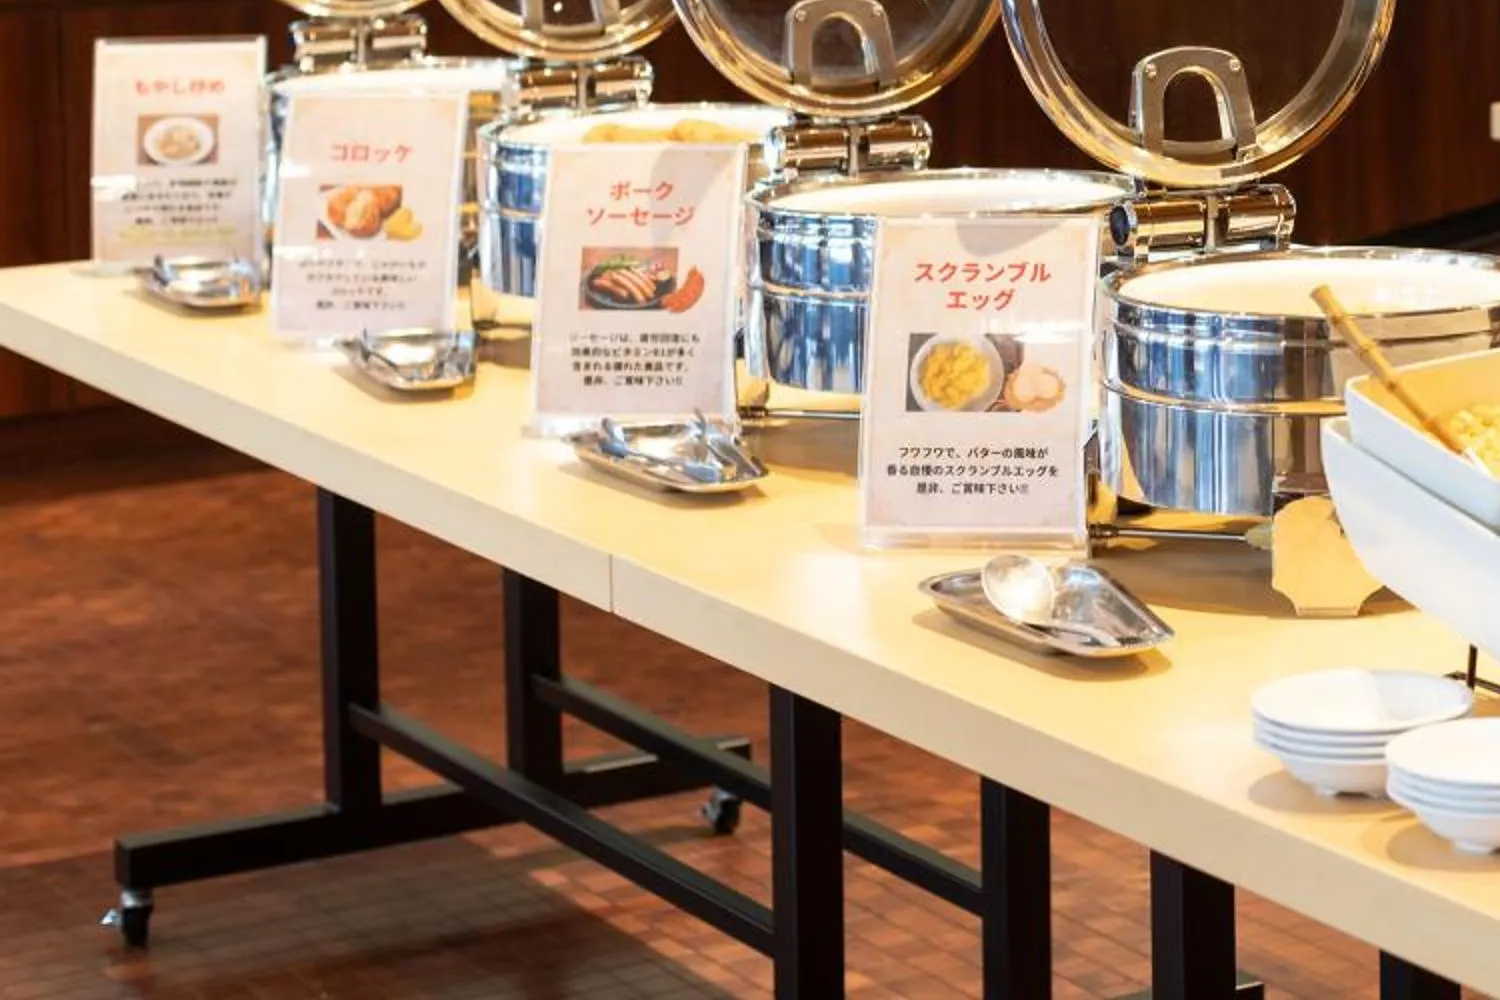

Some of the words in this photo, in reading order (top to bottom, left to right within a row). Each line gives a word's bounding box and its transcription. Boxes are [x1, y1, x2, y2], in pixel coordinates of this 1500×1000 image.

[330, 144, 414, 163] コロッケ
[610, 181, 674, 200] ポーク
[588, 207, 696, 227] ソーセージ
[915, 261, 1053, 284] スクランブル
[946, 291, 1017, 311] エッグ
